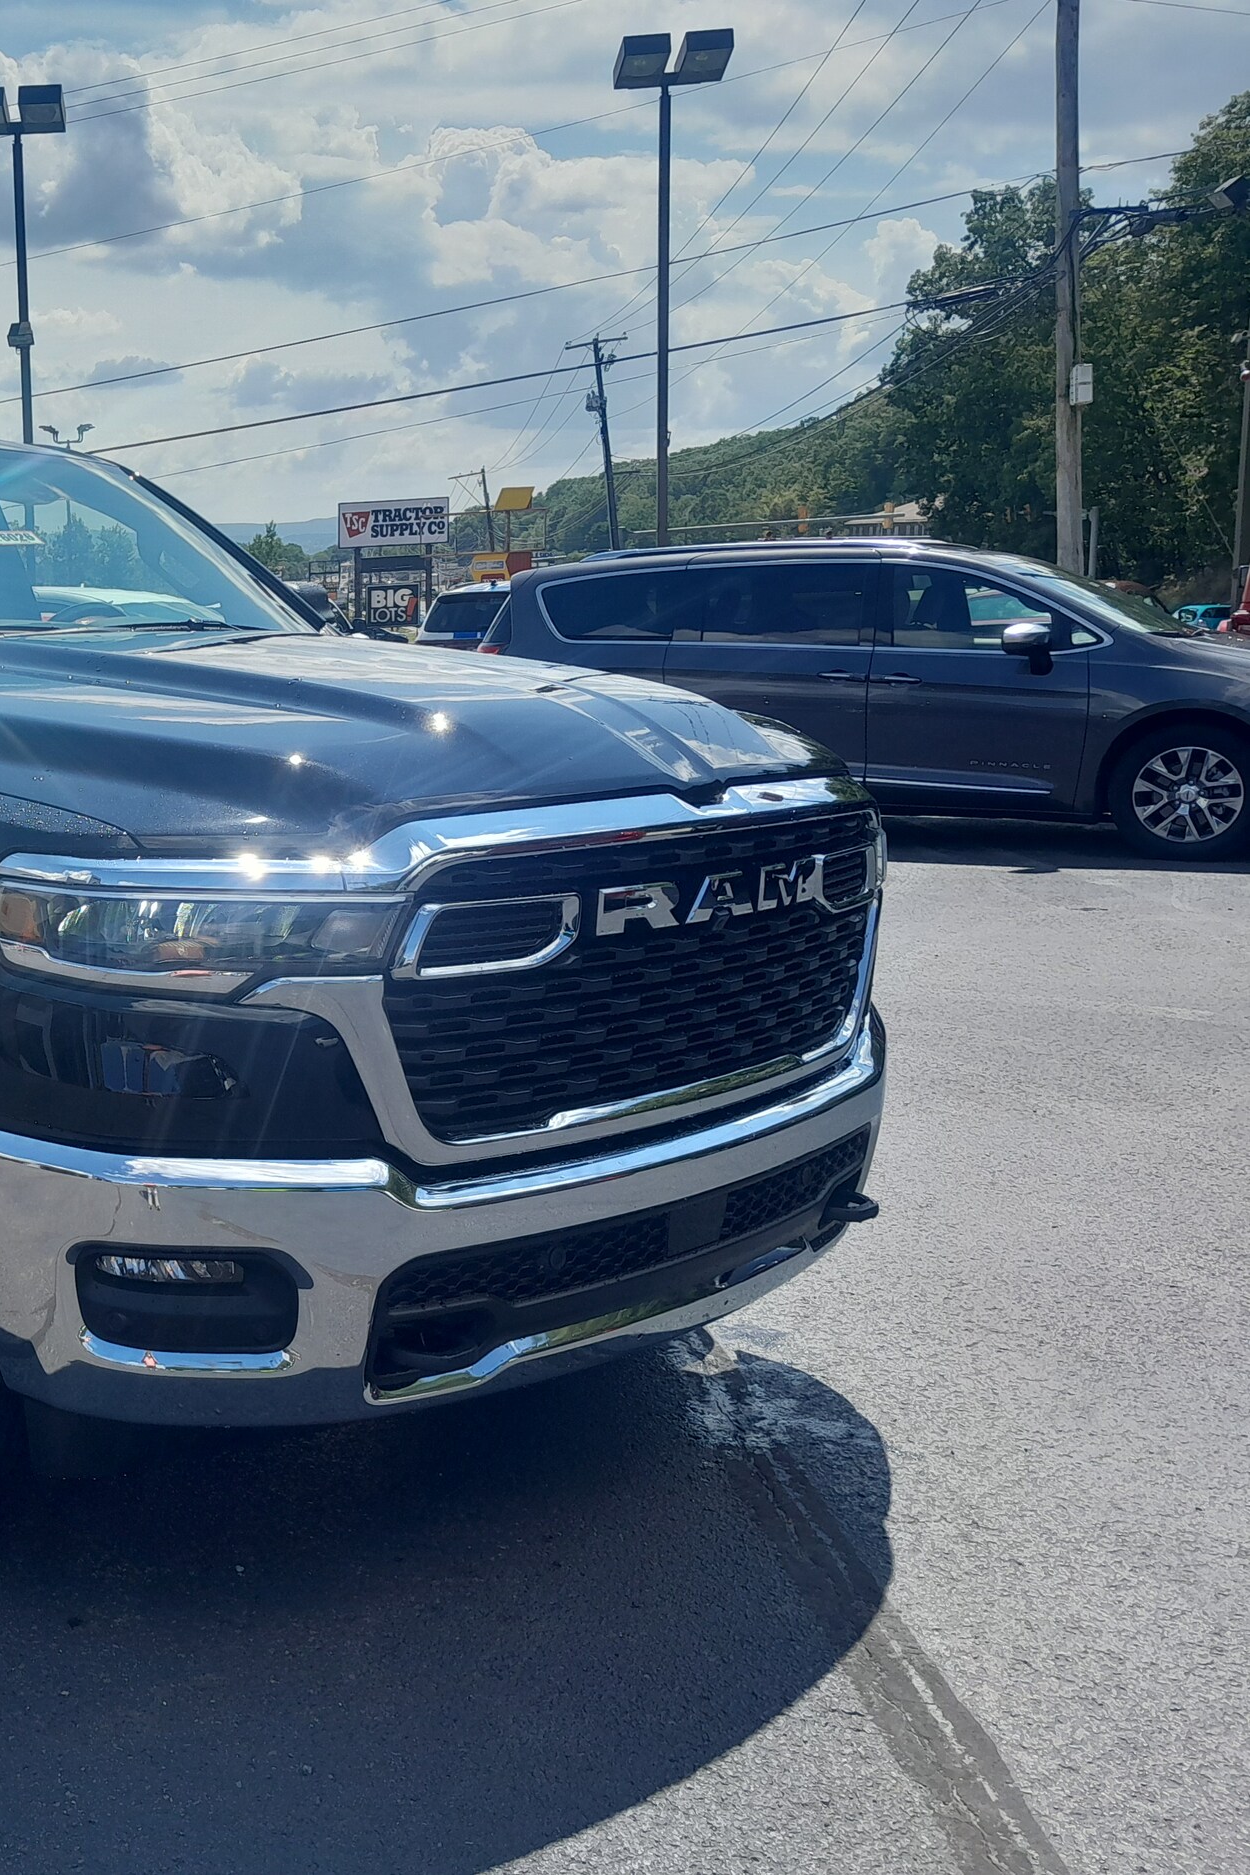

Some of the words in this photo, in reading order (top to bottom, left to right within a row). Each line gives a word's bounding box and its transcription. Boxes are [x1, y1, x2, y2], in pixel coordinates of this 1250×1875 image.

[345, 513, 366, 532] TSC
[371, 506, 444, 523] TRACTOR
[371, 522, 426, 538] SUPPLY
[371, 588, 414, 608] BIG
[969, 760, 1051, 770] PINNACLE
[596, 854, 825, 937] RAM
